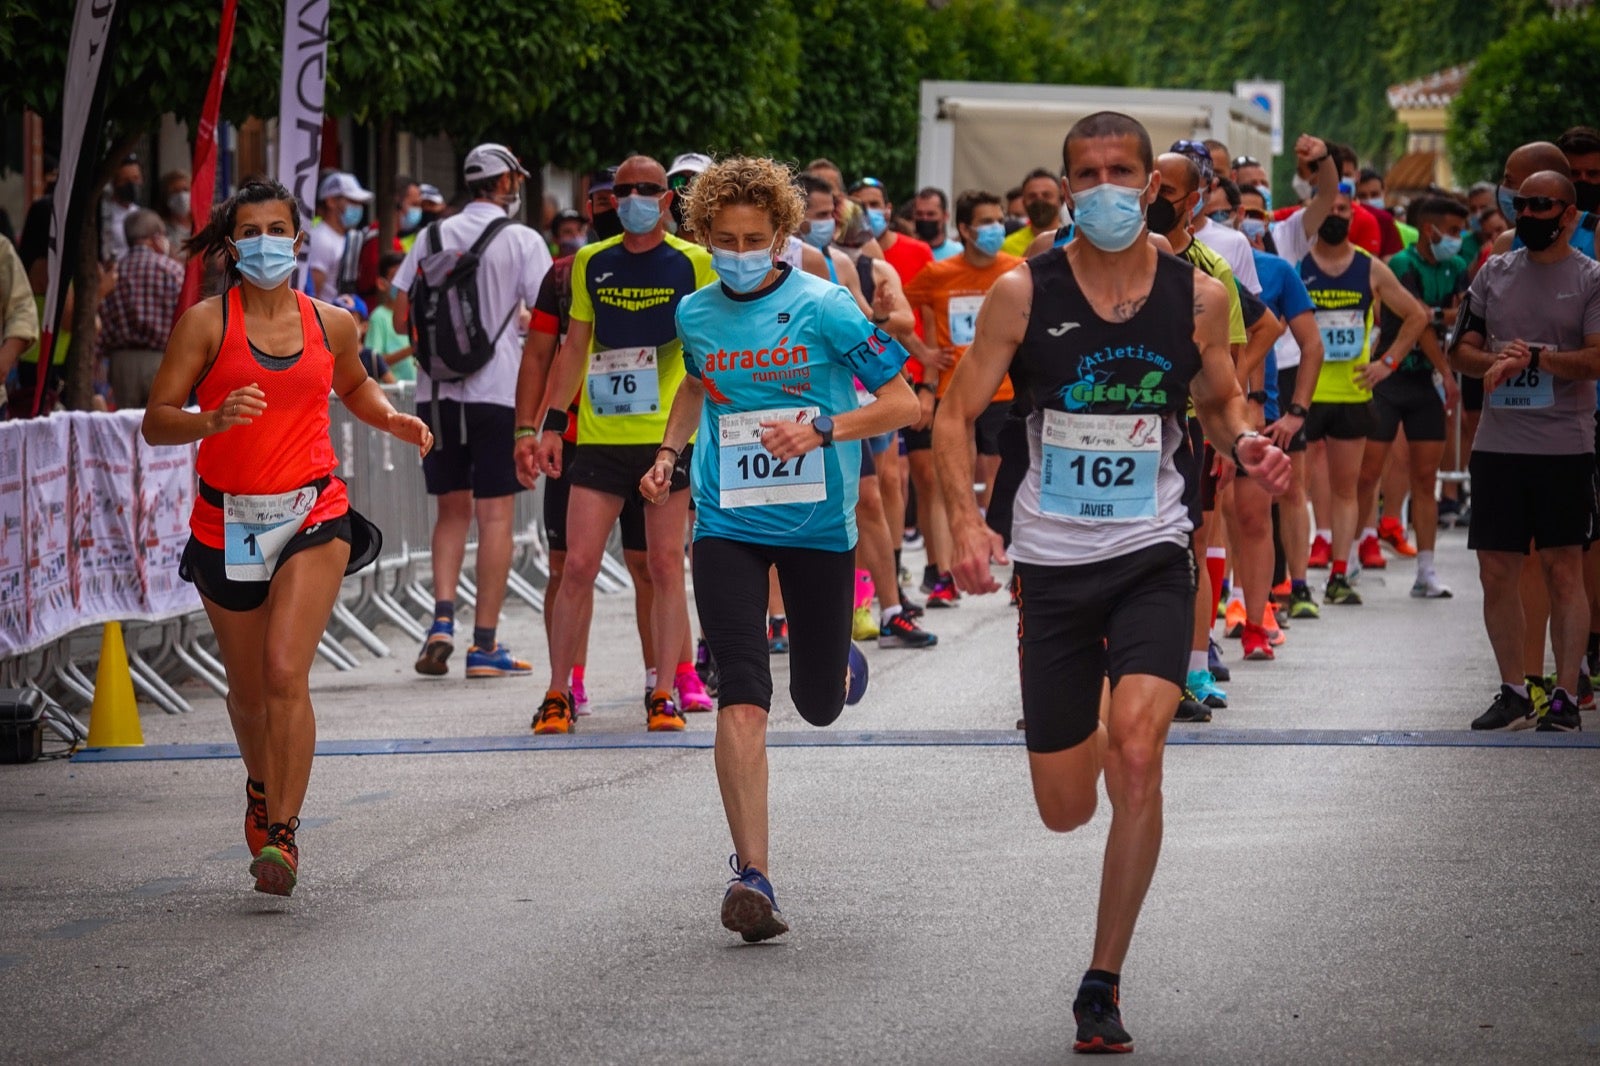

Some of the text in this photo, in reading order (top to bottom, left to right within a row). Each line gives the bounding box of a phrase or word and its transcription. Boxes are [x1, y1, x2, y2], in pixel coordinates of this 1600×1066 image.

[597, 287, 675, 299] ATLETISMO
[1327, 329, 1356, 345] 153
[705, 337, 808, 373] atracón
[1084, 345, 1172, 371] Atletismo
[611, 374, 637, 395] 76
[752, 366, 811, 384] running
[737, 453, 806, 480] 1027
[1070, 455, 1136, 487] 162
[1079, 502, 1114, 517] JAVIER
